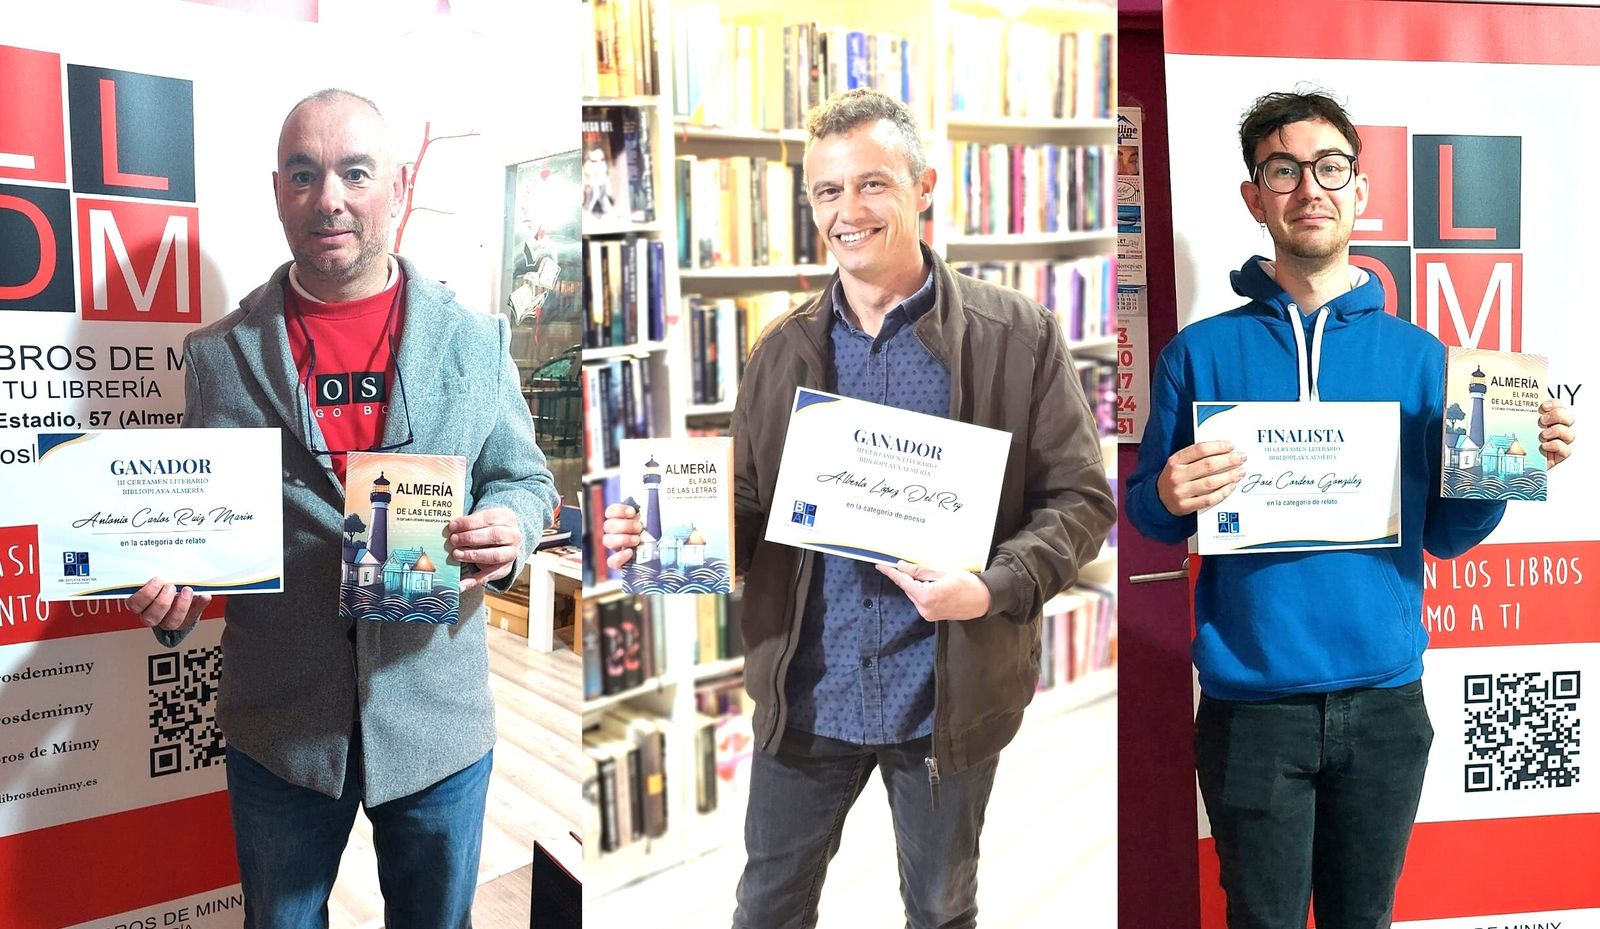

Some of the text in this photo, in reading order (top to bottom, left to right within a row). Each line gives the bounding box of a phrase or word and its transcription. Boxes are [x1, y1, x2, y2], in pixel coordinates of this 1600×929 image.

[1439, 144, 1497, 240] L
[110, 346, 155, 371] DE
[3, 376, 162, 400] TU LIBRERÍA
[1490, 376, 1539, 390] ALMERÍA
[1515, 399, 1539, 408] LETRAS
[89, 411, 112, 427] 57
[119, 410, 184, 430] (Almer
[315, 408, 342, 418] GO
[854, 428, 943, 461] GANADOR
[1257, 429, 1345, 443] FINALISTA
[110, 458, 212, 476] GANADOR
[665, 460, 718, 475] ALMERÍA
[127, 478, 168, 487] CERTAMEN
[169, 477, 209, 486] LITERARIO
[396, 481, 454, 497] ALMERÍA
[699, 477, 717, 485] FARO
[1275, 471, 1315, 490] Cordero
[122, 487, 171, 496] BIBLIOPLAYA
[692, 486, 718, 494] LETRAS
[816, 471, 964, 513] Alberto López Del Rey
[432, 500, 453, 508] FARO
[72, 511, 129, 528] Antonio
[131, 507, 170, 528] Carlos
[173, 508, 205, 526] Ruiz
[408, 508, 422, 516] LAS
[424, 509, 452, 518] LETRAS
[894, 511, 903, 520] de
[131, 538, 138, 546] la
[174, 537, 184, 545] de
[185, 537, 206, 545] relato
[0, 543, 35, 577] SI
[1452, 559, 1492, 589] LOS
[1506, 556, 1583, 588] LIBROS
[1471, 603, 1485, 632] A
[1500, 602, 1521, 631] TI
[30, 745, 48, 759] de
[51, 739, 100, 755] Minny
[164, 907, 190, 926] DE
